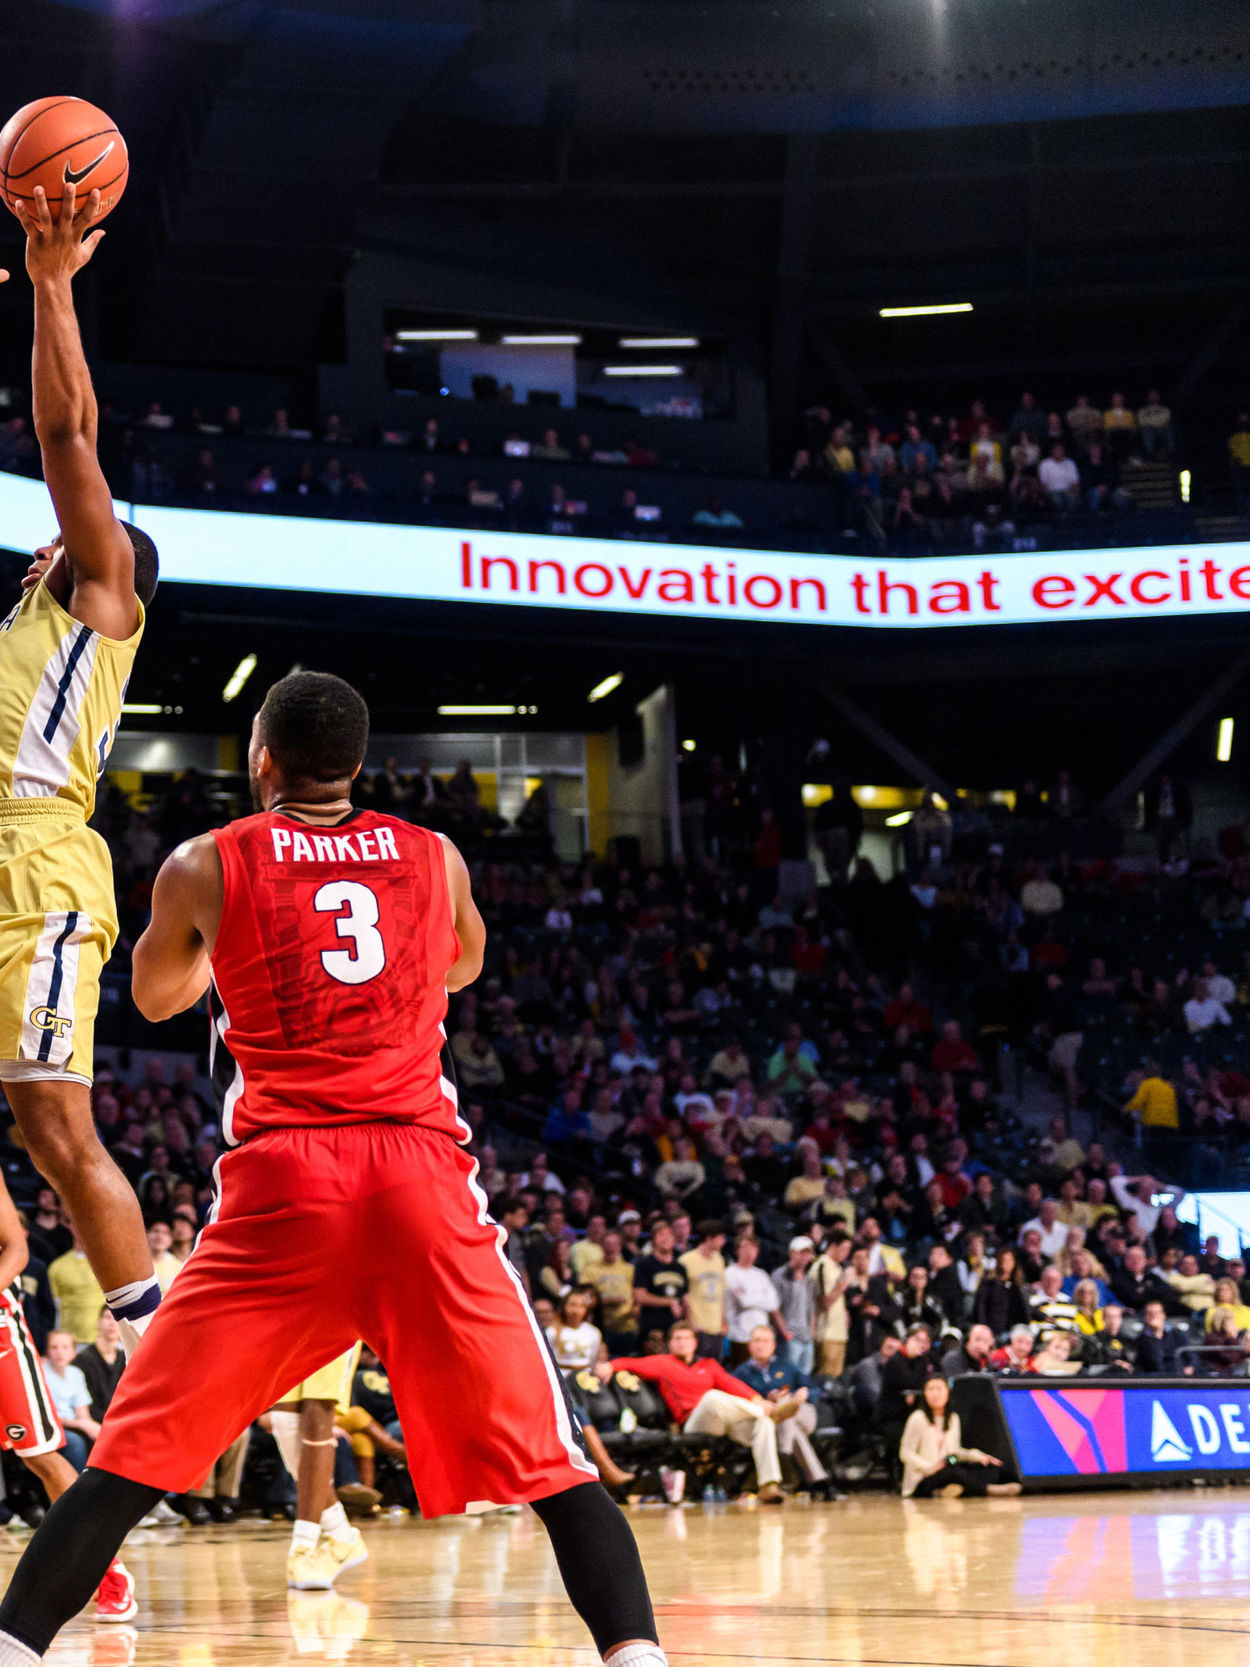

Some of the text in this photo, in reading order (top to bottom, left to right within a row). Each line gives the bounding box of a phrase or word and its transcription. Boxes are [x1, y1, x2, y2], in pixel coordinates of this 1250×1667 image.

[460, 541, 828, 612] Innovation
[850, 571, 1001, 615] that
[270, 827, 400, 862] PARKER
[313, 879, 387, 985] 3
[1186, 1403, 1250, 1455] DE
